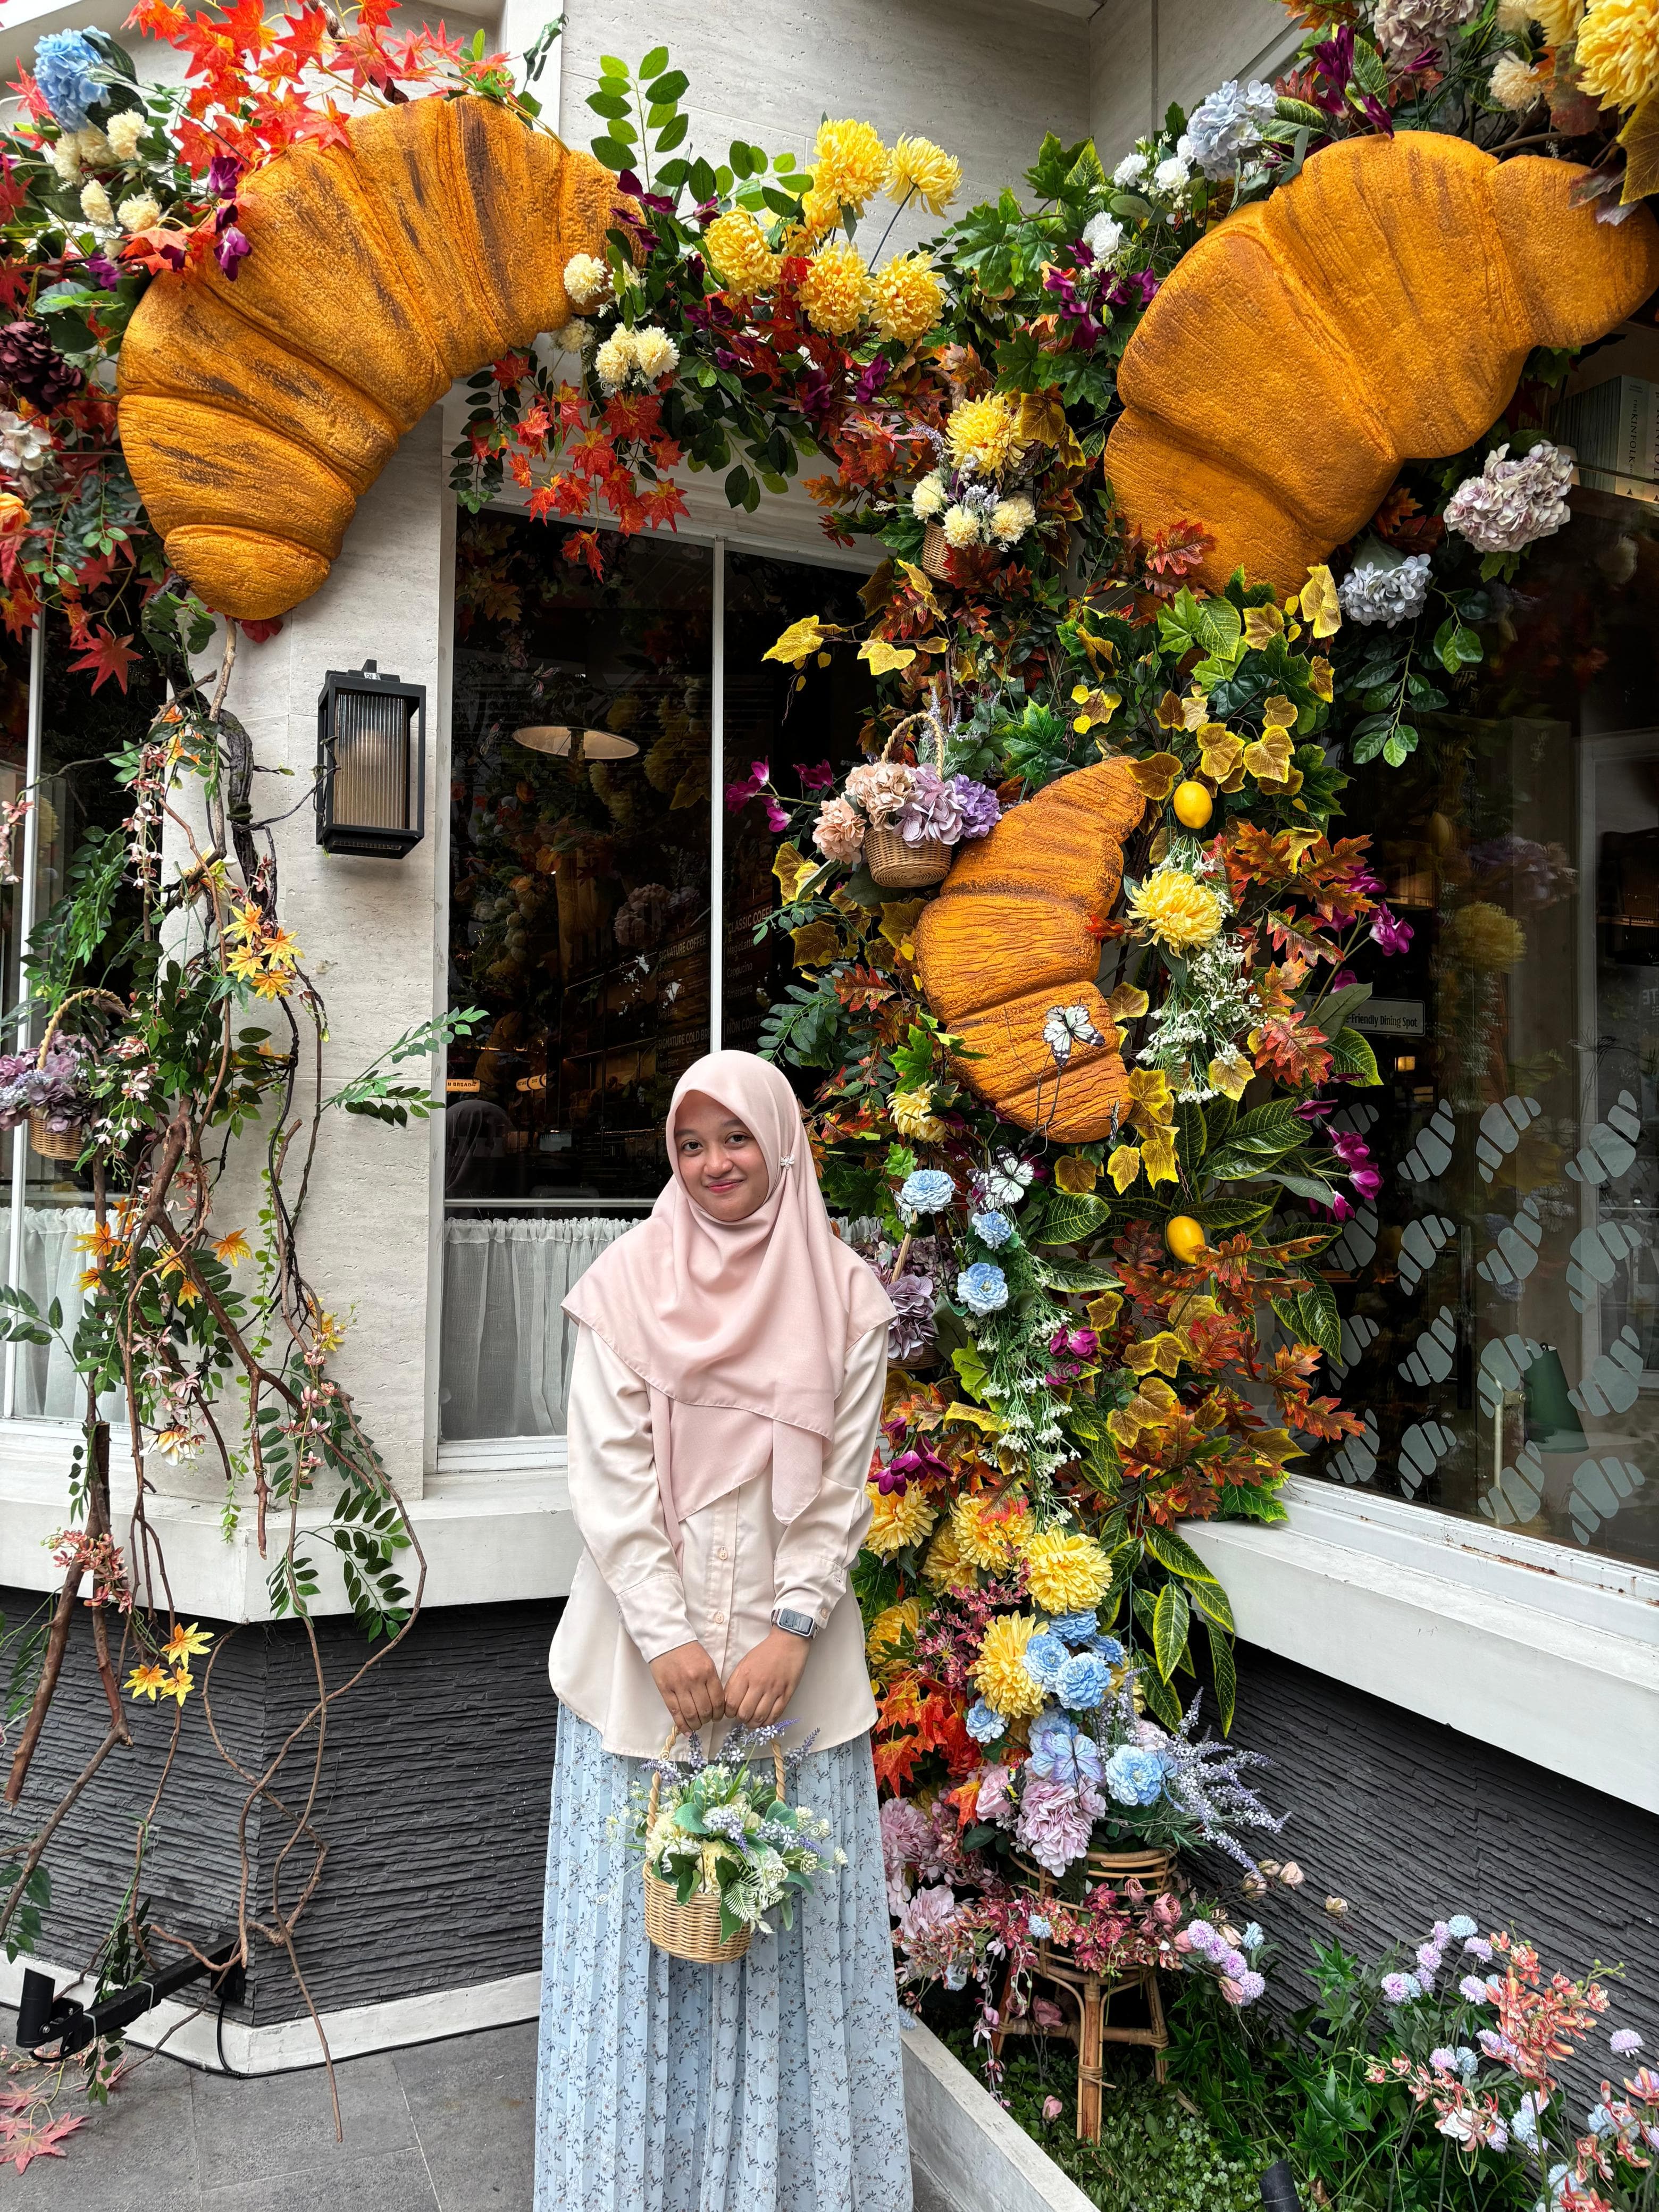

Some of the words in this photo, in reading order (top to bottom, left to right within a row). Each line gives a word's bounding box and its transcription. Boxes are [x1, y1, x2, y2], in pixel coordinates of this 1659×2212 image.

[1629, 413, 1638, 463] KINFOLK
[727, 914, 752, 934] CLASSIC
[659, 941, 686, 959] SIGNATURE
[686, 934, 707, 951] COFFEE
[727, 984, 753, 1000] Americano
[727, 1020, 740, 1034] NON
[1380, 1015, 1401, 1028] Dining
[1402, 1017, 1418, 1029] Spot
[658, 1034, 685, 1050] SIGNATURE
[685, 1030, 700, 1044] COLD
